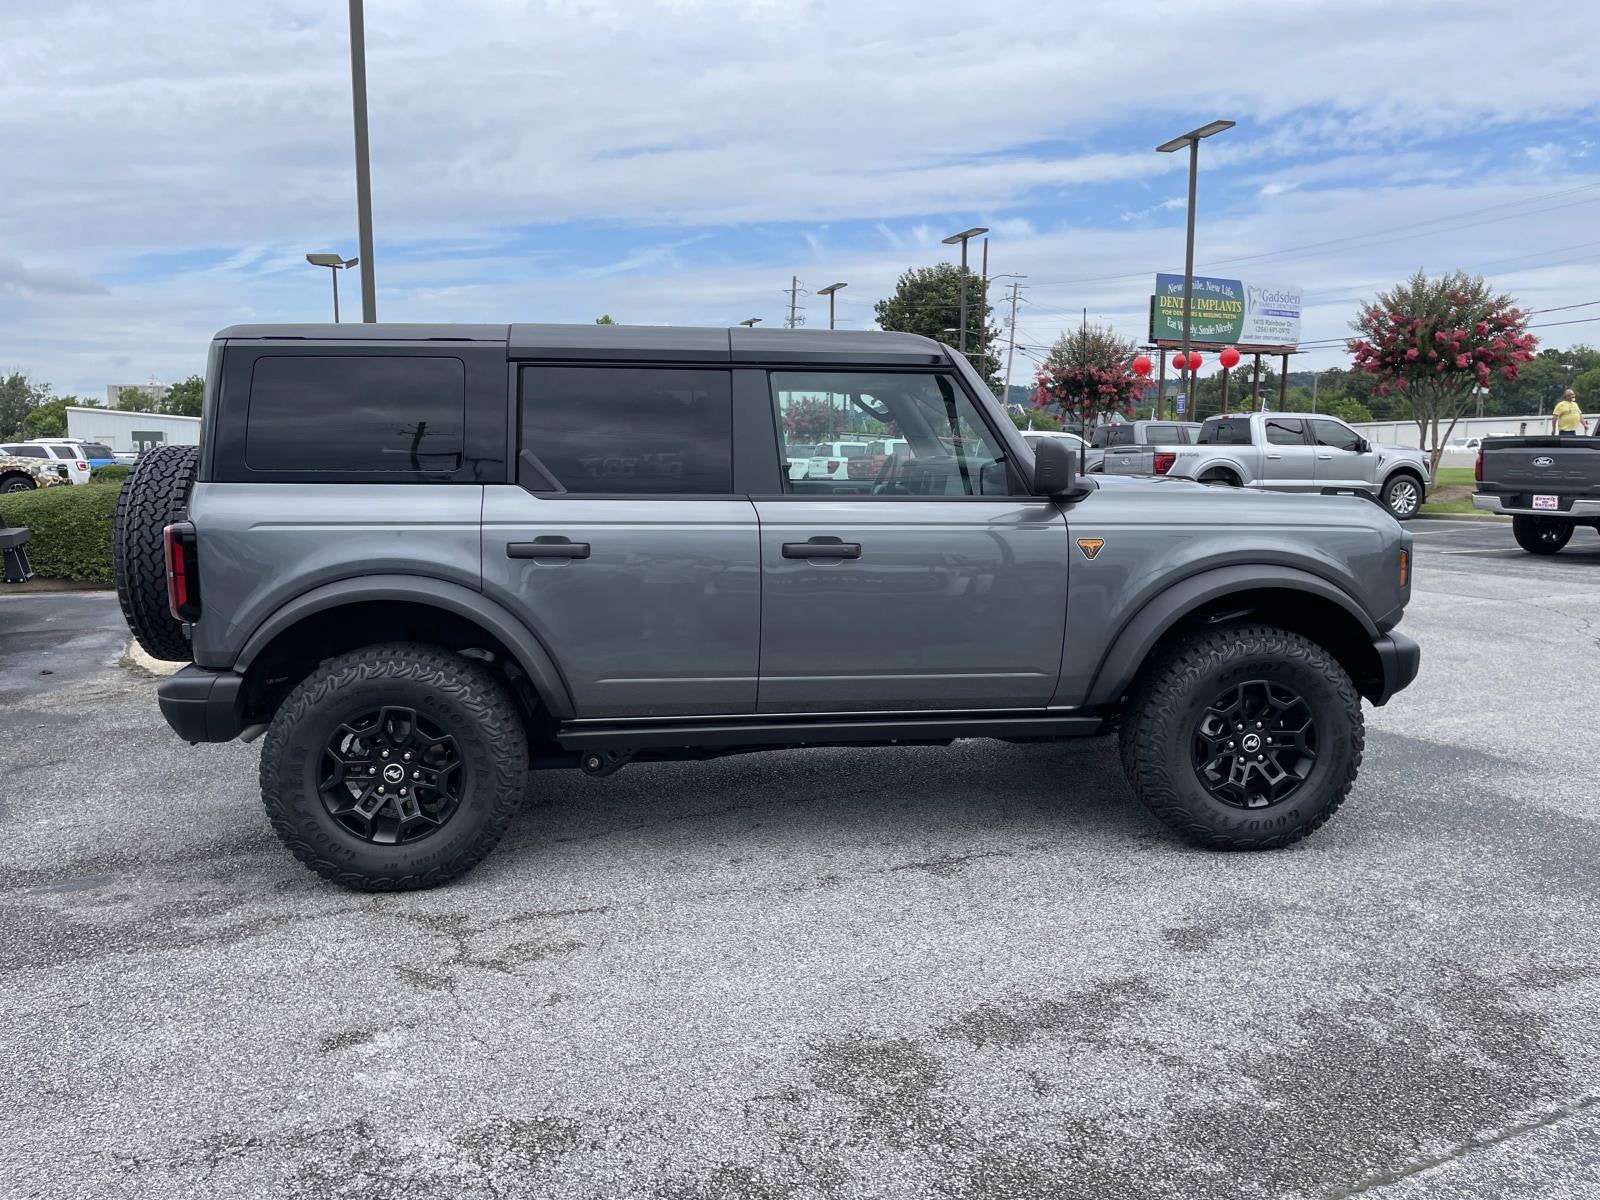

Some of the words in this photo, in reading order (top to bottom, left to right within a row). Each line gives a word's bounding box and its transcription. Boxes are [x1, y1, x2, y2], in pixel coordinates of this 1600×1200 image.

[1168, 283, 1183, 294] New
[1206, 281, 1220, 292] New
[1160, 296, 1195, 309] DENTL
[1197, 298, 1242, 312] IMPLANTS
[1262, 289, 1300, 304] Gadsden
[1167, 316, 1177, 329] Eat
[1199, 324, 1216, 335] Smile
